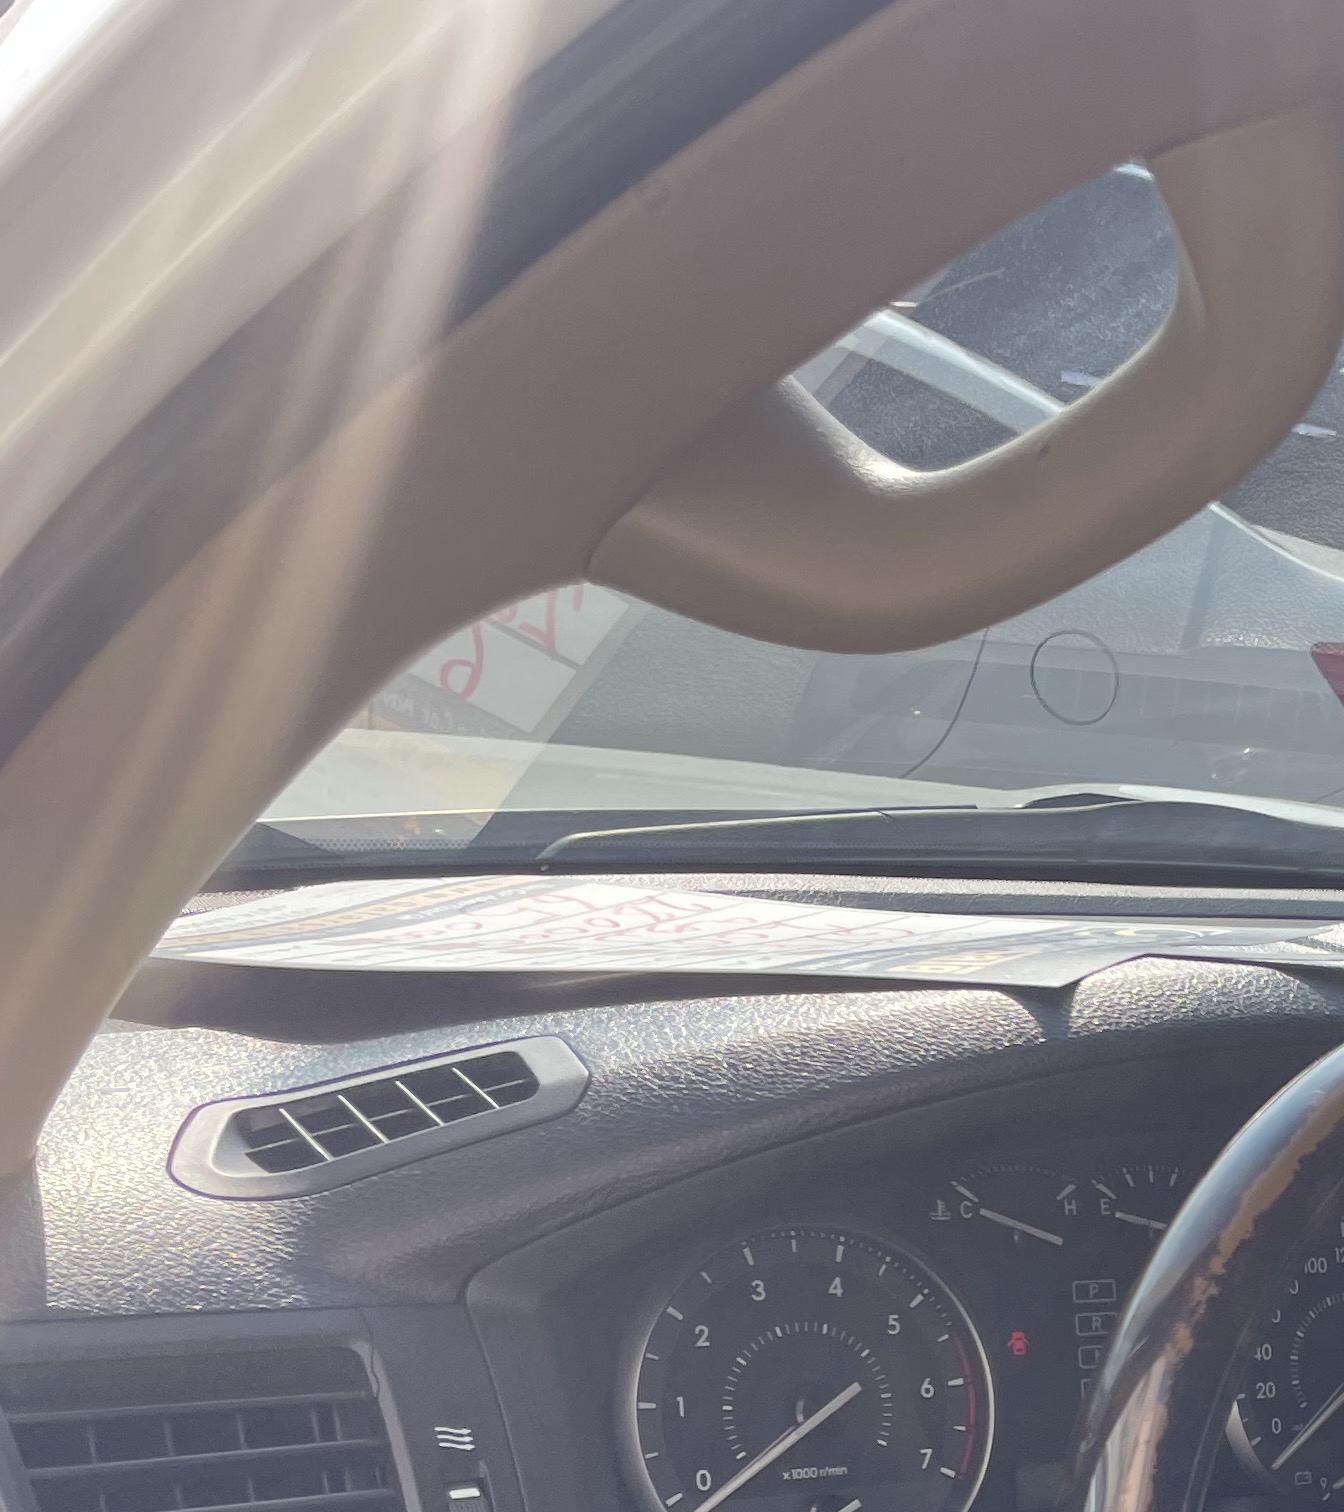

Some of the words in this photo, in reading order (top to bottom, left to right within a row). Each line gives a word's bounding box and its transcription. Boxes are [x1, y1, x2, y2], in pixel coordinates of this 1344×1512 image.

[960, 1202, 973, 1219] C
[1064, 1199, 1077, 1216] H
[1100, 1199, 1111, 1215] E
[752, 1280, 766, 1301] 3
[828, 1277, 843, 1297] 4
[1089, 1284, 1099, 1298] P
[888, 1314, 901, 1334] 5
[694, 1325, 711, 1347] 2
[920, 1377, 934, 1398] 6
[1256, 1382, 1276, 1399] 20
[676, 1396, 685, 1417] 1
[1271, 1418, 1282, 1434] 0
[919, 1449, 933, 1469] 7
[696, 1469, 712, 1491] 0
[1320, 1477, 1327, 1489] 9
